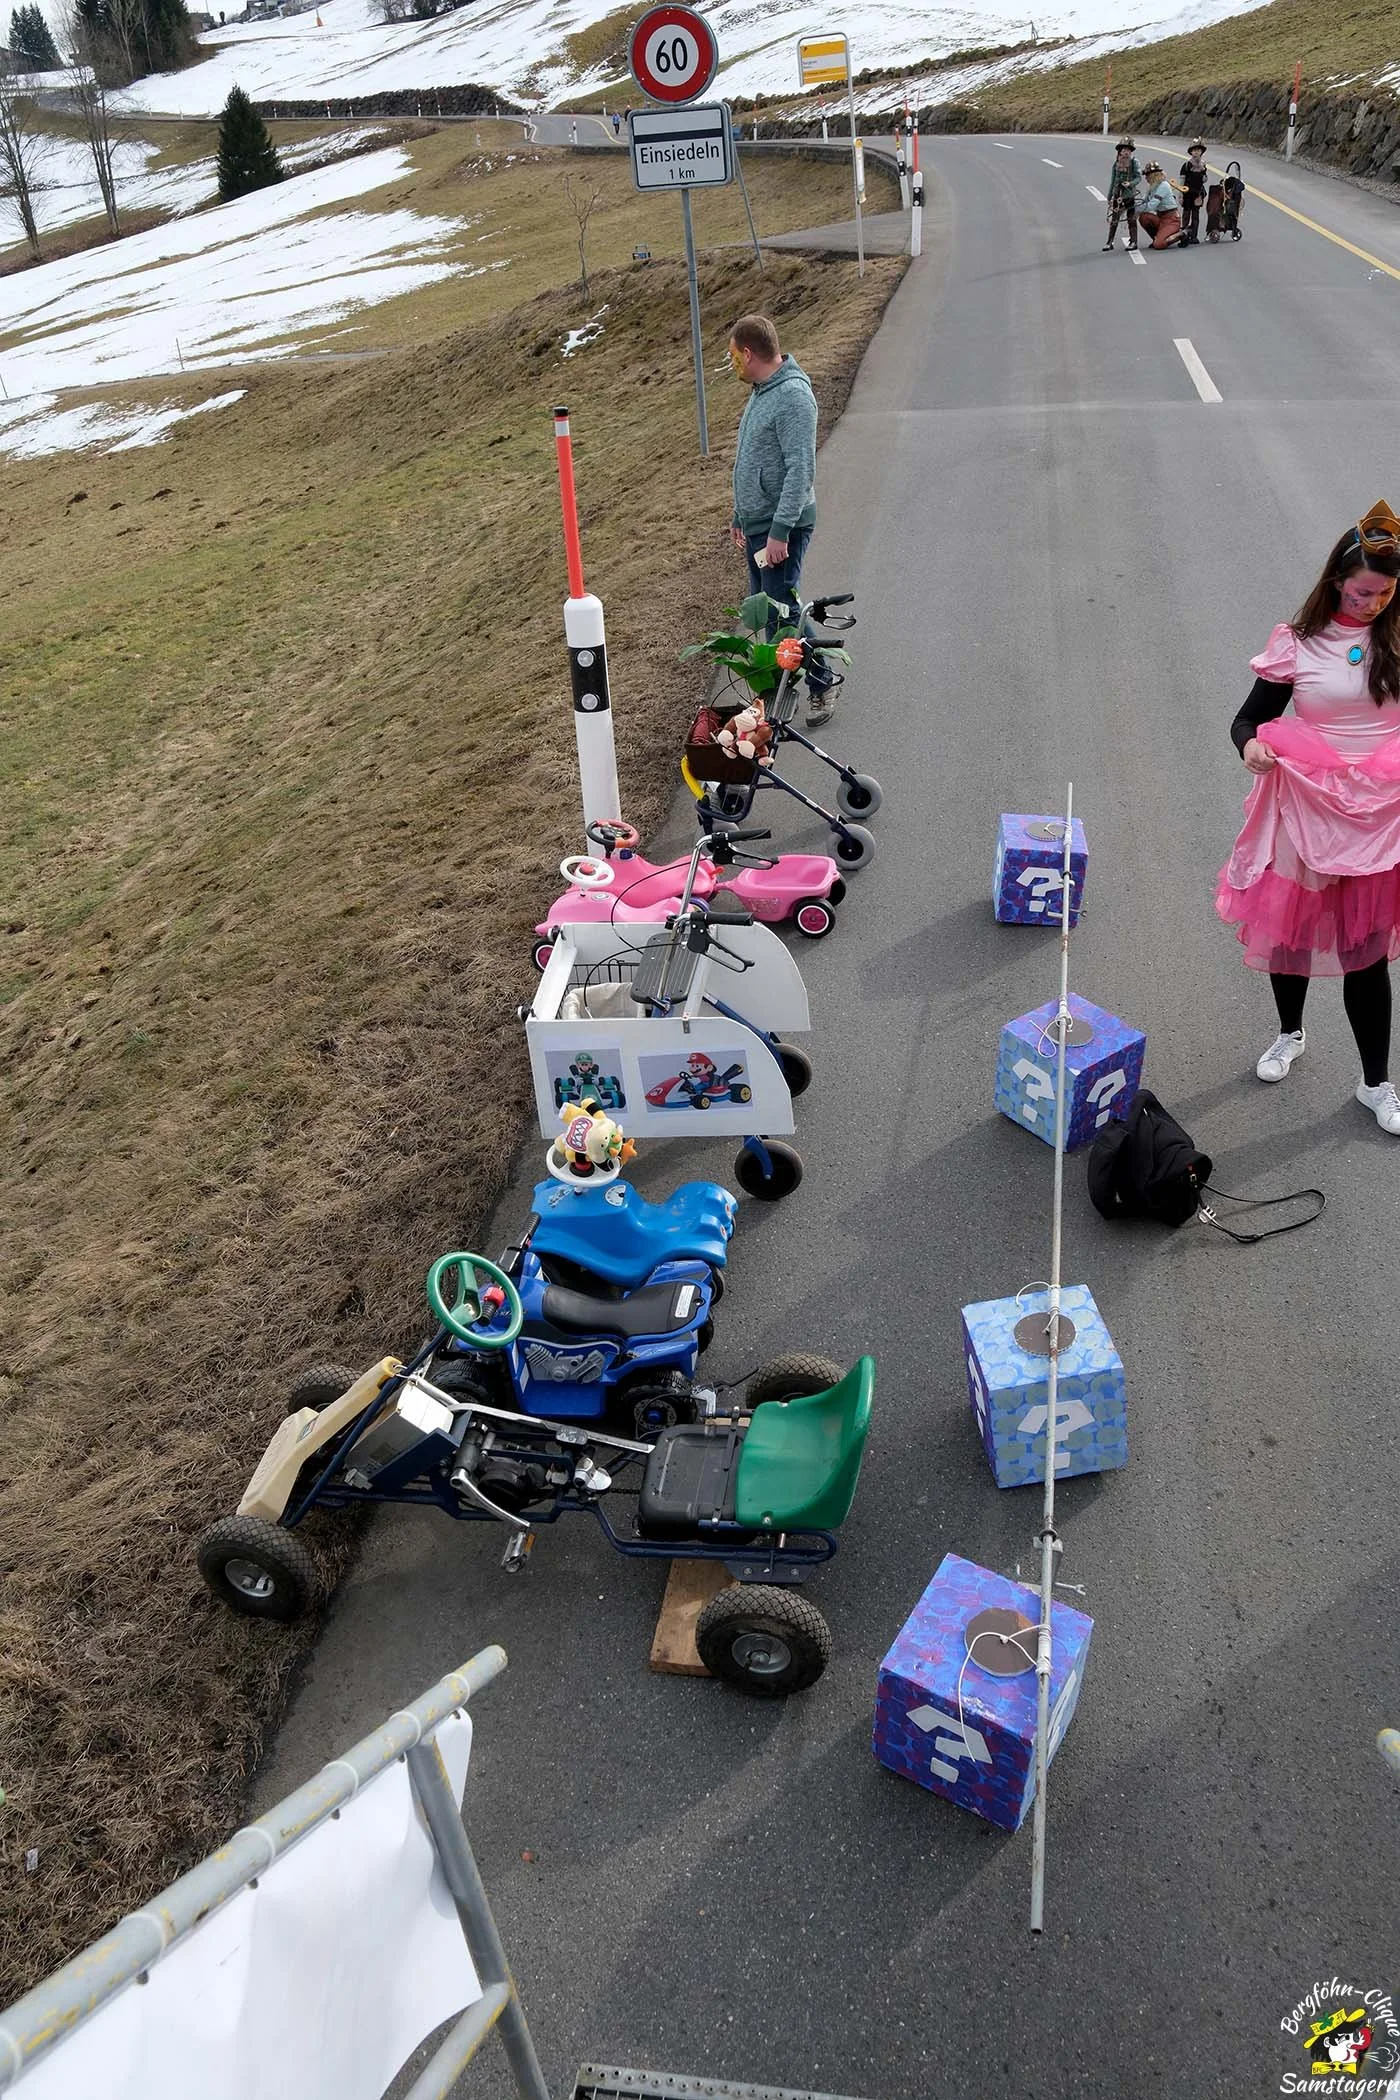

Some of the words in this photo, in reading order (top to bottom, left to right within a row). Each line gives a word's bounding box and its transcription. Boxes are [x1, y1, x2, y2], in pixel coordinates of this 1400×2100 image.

[656, 37, 687, 73] 60
[640, 141, 719, 164] Einsiedeln
[669, 169, 675, 180] 1
[678, 168, 695, 179] km
